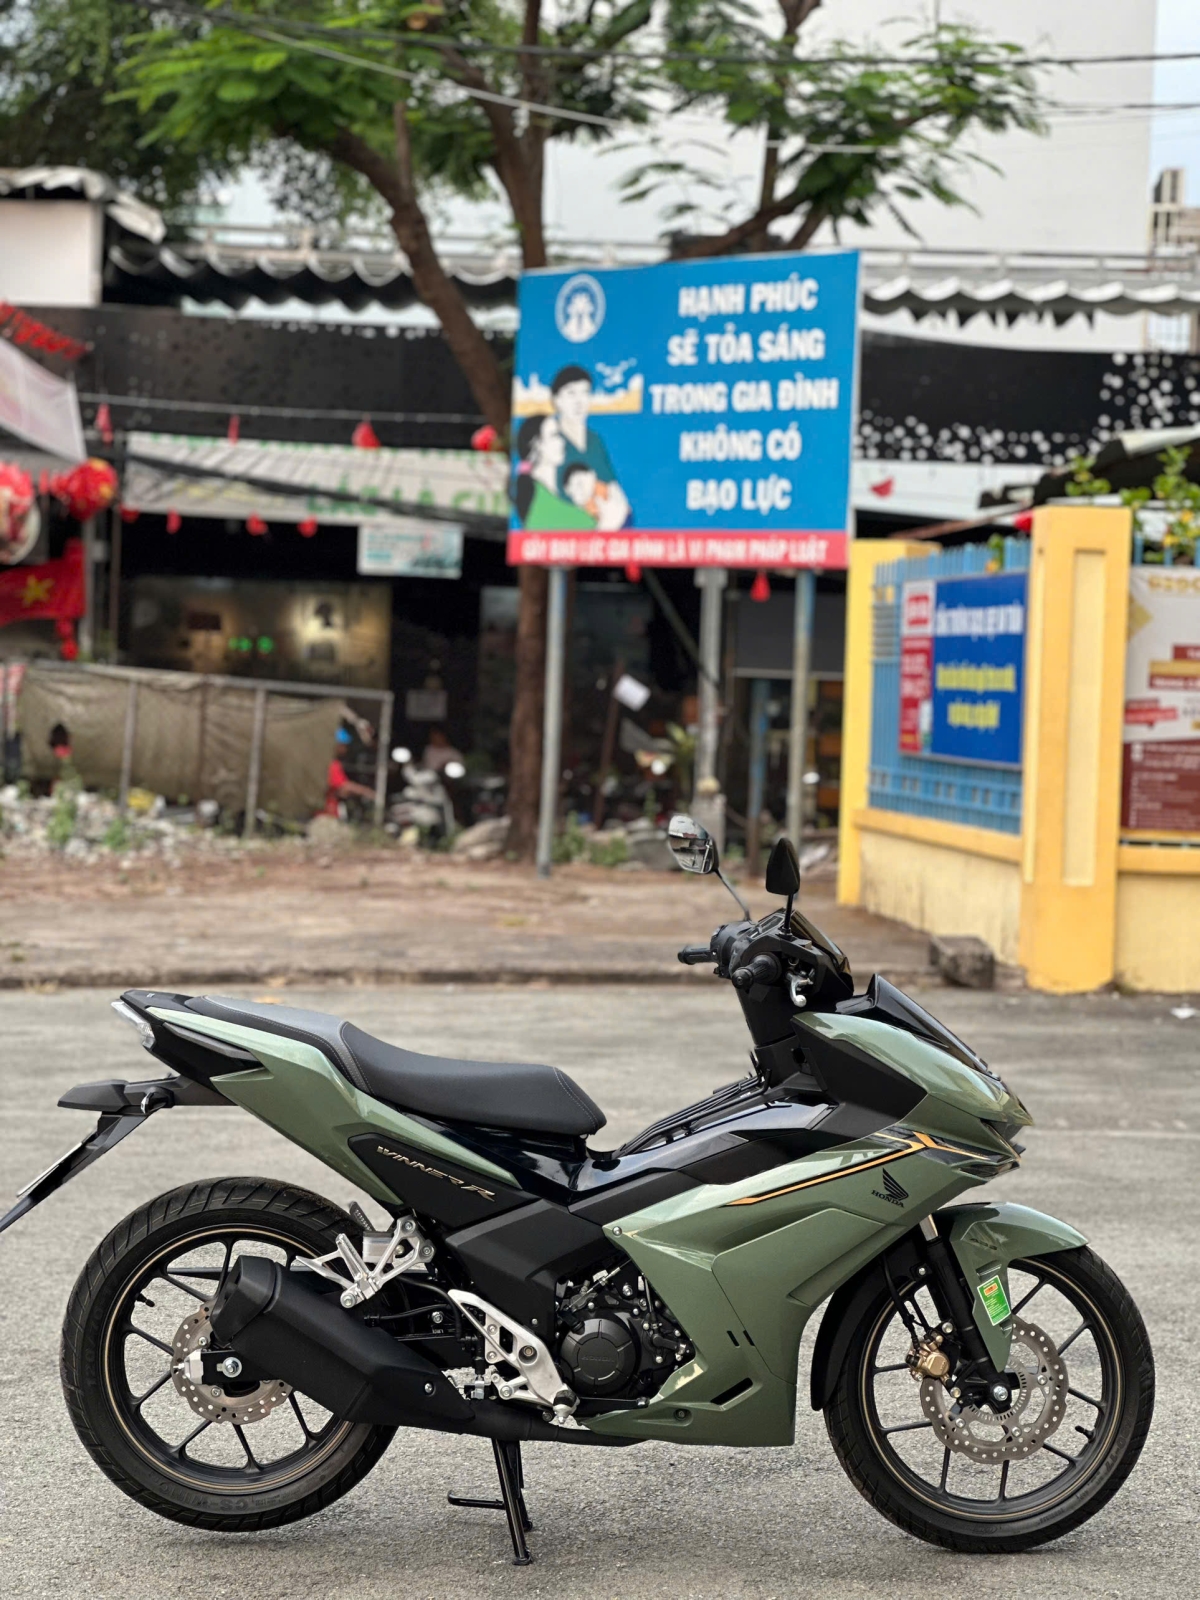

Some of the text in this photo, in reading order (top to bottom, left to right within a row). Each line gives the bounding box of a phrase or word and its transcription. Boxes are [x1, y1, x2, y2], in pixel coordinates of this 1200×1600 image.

[678, 272, 819, 322] HẠNH PHÚC
[667, 322, 825, 366] SẼ TỎA SÁNG
[648, 372, 840, 414] TRONG GIA ĐÌNH
[679, 421, 802, 462] KHÔNG CÓ
[686, 474, 792, 515] BẠO LỰC
[377, 1145, 496, 1202] WINNER R
[871, 1189, 905, 1209] HONDA
